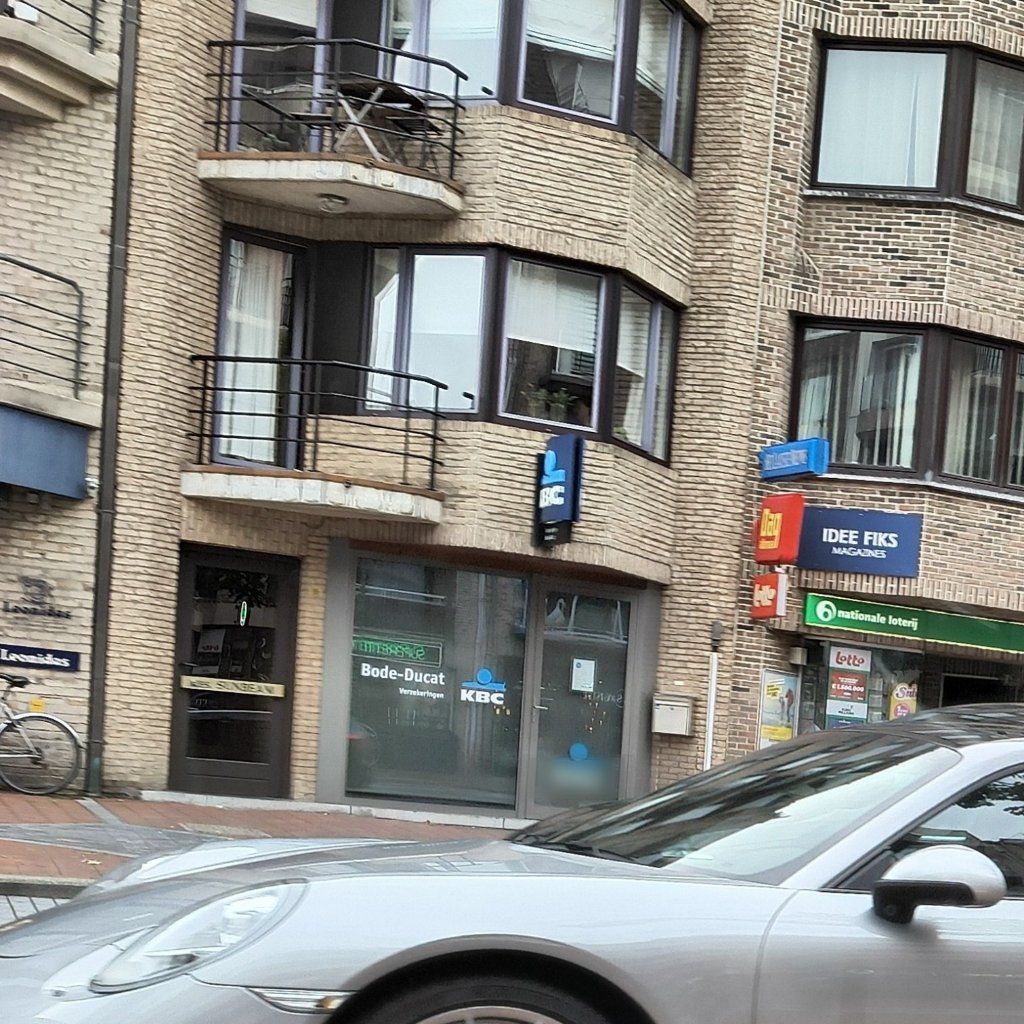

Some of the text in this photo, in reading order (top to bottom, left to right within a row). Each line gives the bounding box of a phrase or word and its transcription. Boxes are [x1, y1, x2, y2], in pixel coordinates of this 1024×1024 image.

[539, 485, 566, 509] BC
[822, 528, 898, 548] IDEE FIKS
[832, 547, 887, 559] MAGAZINES
[837, 609, 918, 631] nationale loterij
[0, 648, 71, 667] Leonidas
[361, 662, 446, 686] Bode-Ducat
[398, 687, 444, 700] Verzekeringen
[460, 689, 504, 705] KBC
